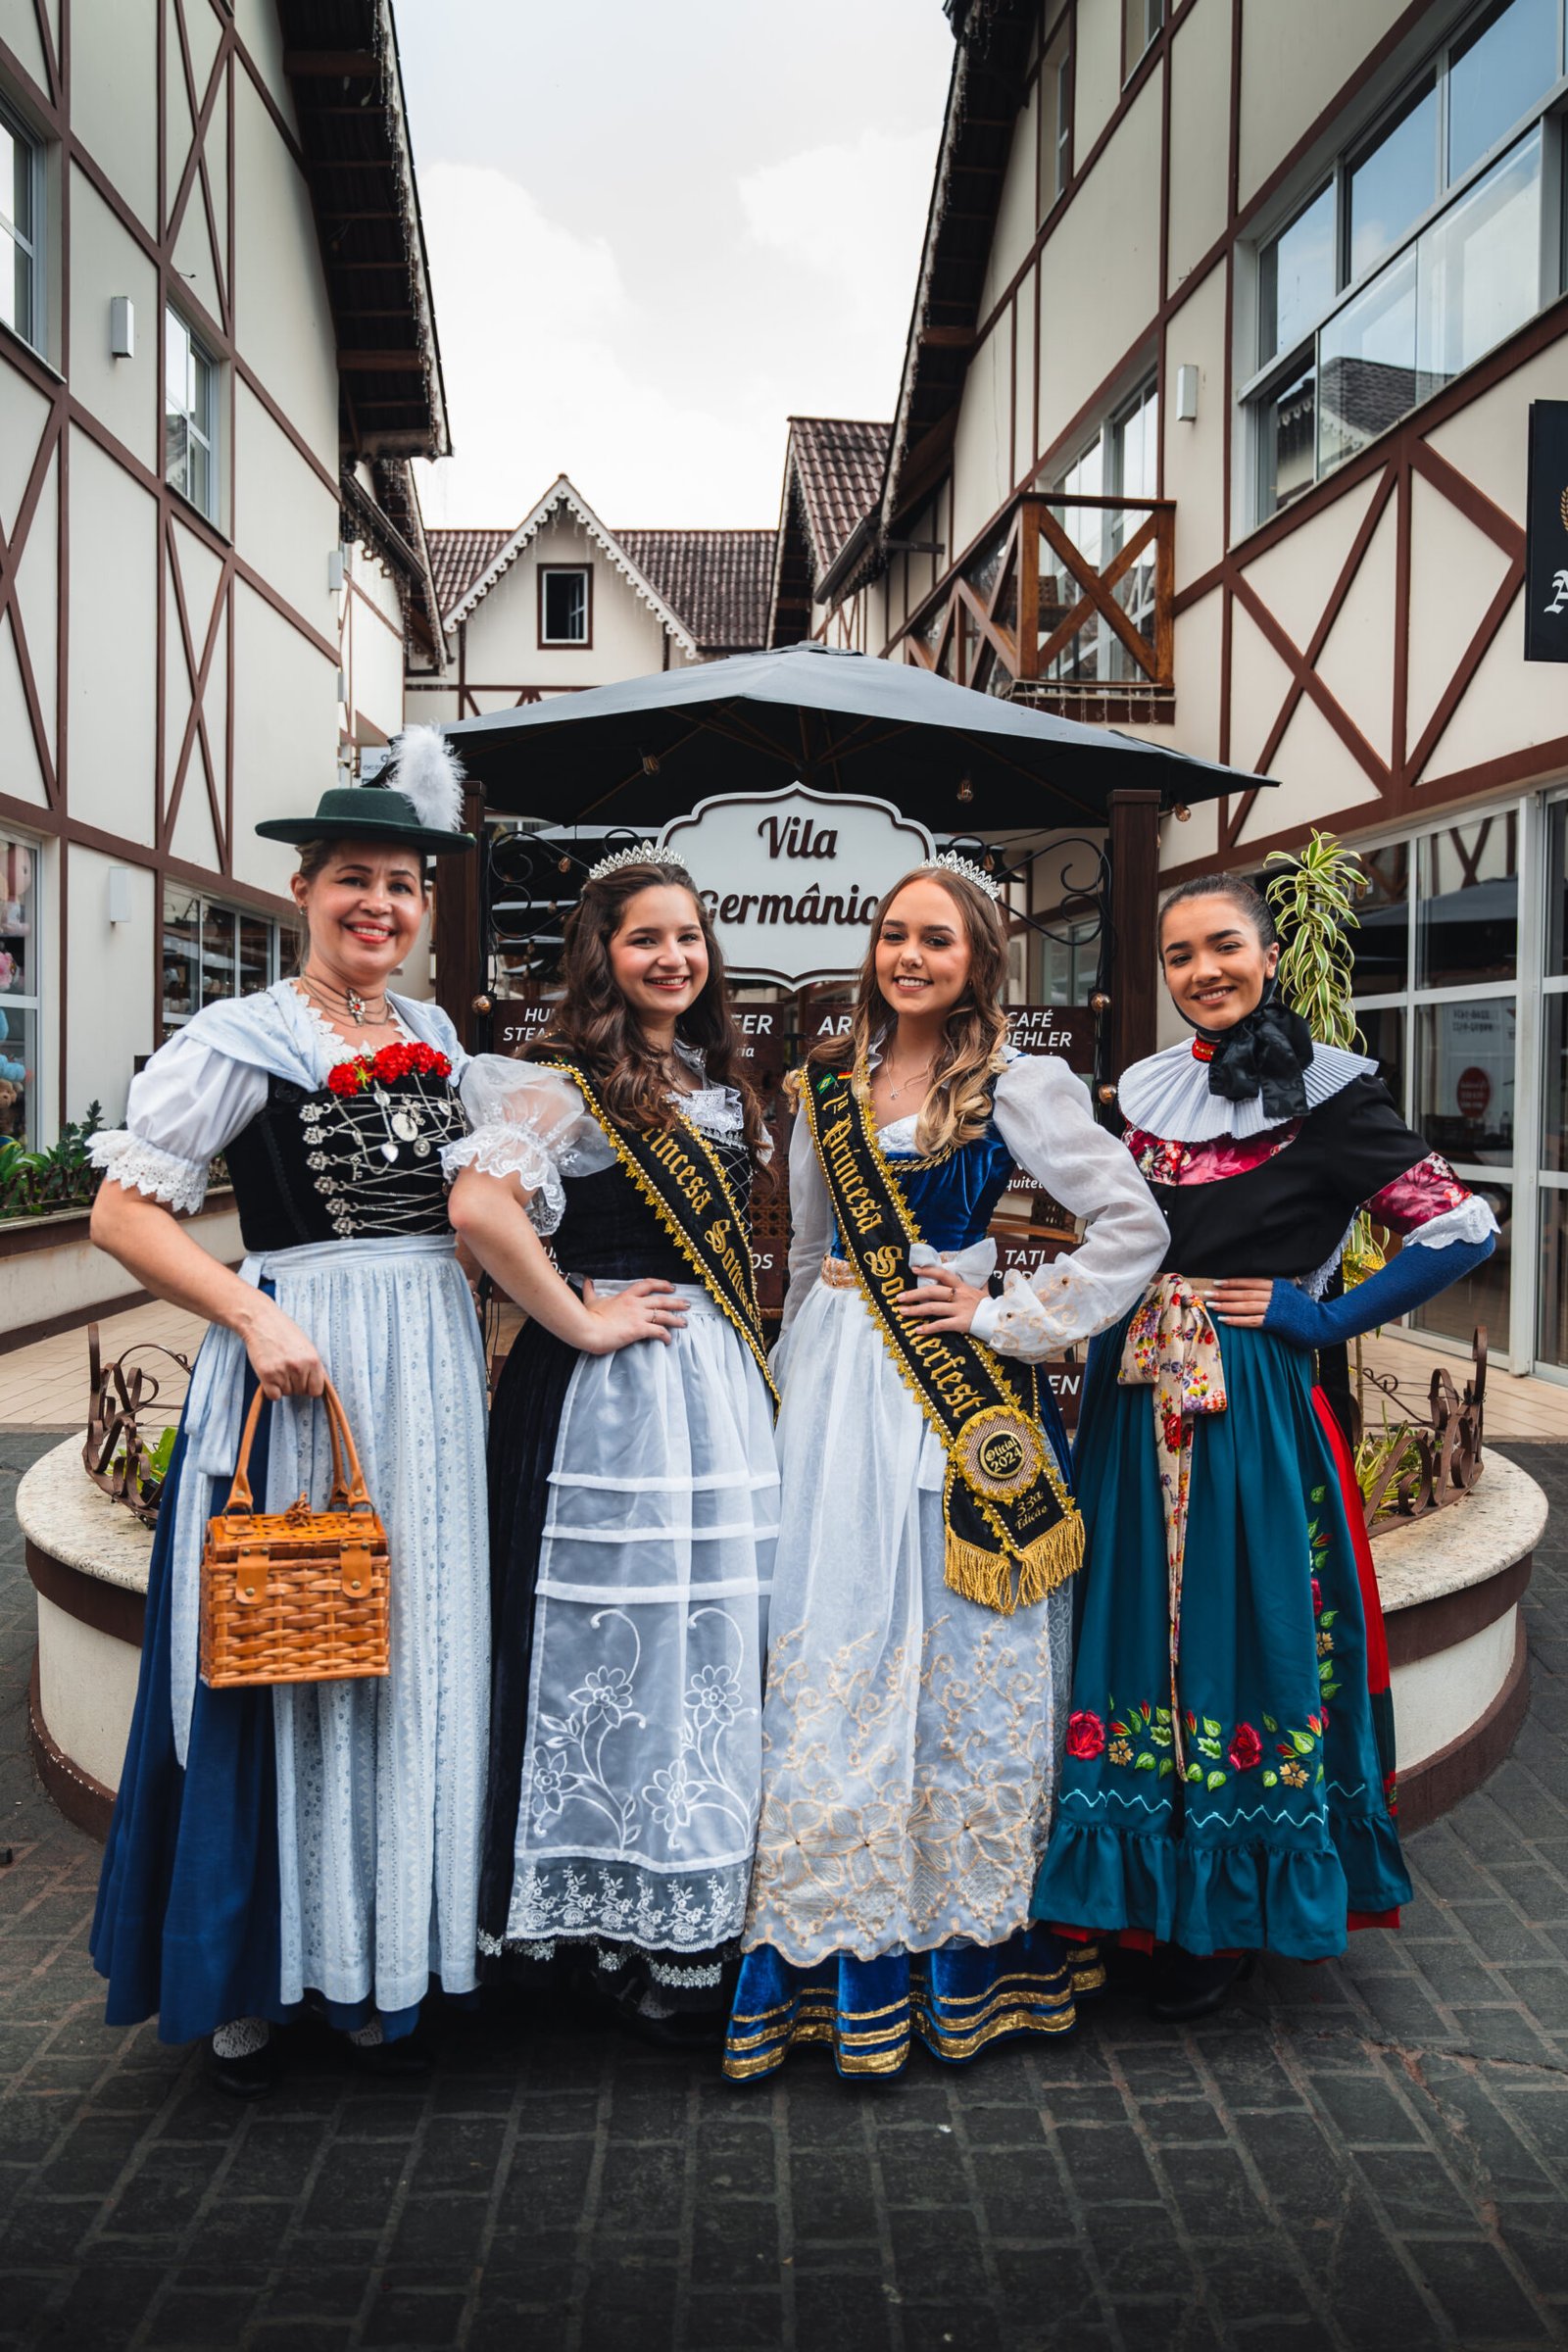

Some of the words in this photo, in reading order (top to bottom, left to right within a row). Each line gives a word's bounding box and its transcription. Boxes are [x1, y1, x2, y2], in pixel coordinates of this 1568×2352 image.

[758, 815, 838, 859] Vila
[698, 882, 879, 926] Germânic
[524, 1007, 556, 1023] HU
[816, 1015, 853, 1036] AR
[1006, 1008, 1054, 1028] CAFÉ
[641, 1127, 713, 1215] rincesa
[821, 1112, 884, 1236] Princesa
[862, 1245, 988, 1419] Somerfest
[1004, 1250, 1046, 1266] TATI
[985, 1436, 1018, 1462] Oficial
[990, 1446, 1023, 1474] 2024
